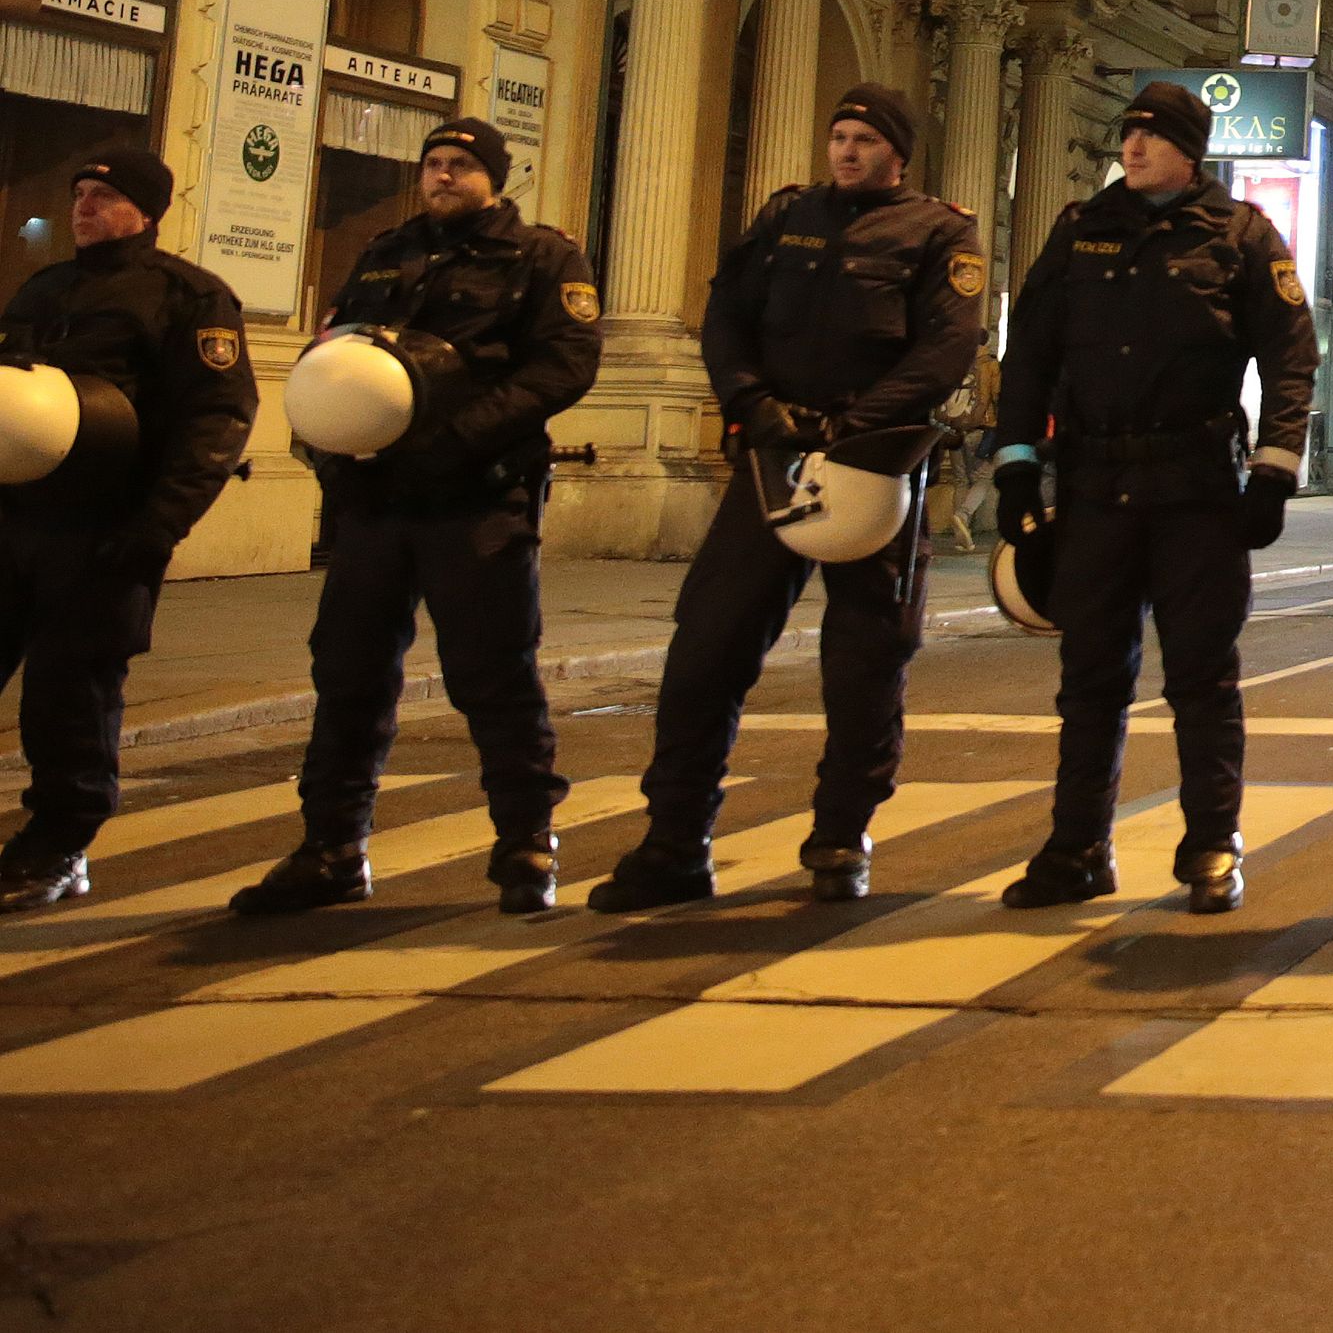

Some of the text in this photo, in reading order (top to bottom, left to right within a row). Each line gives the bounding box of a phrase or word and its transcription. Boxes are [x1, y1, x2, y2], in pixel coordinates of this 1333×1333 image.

[235, 49, 305, 88] HEGA
[232, 79, 304, 107] PRÄPARATE
[246, 126, 279, 151] HEGA
[1209, 115, 1287, 140] UKAS
